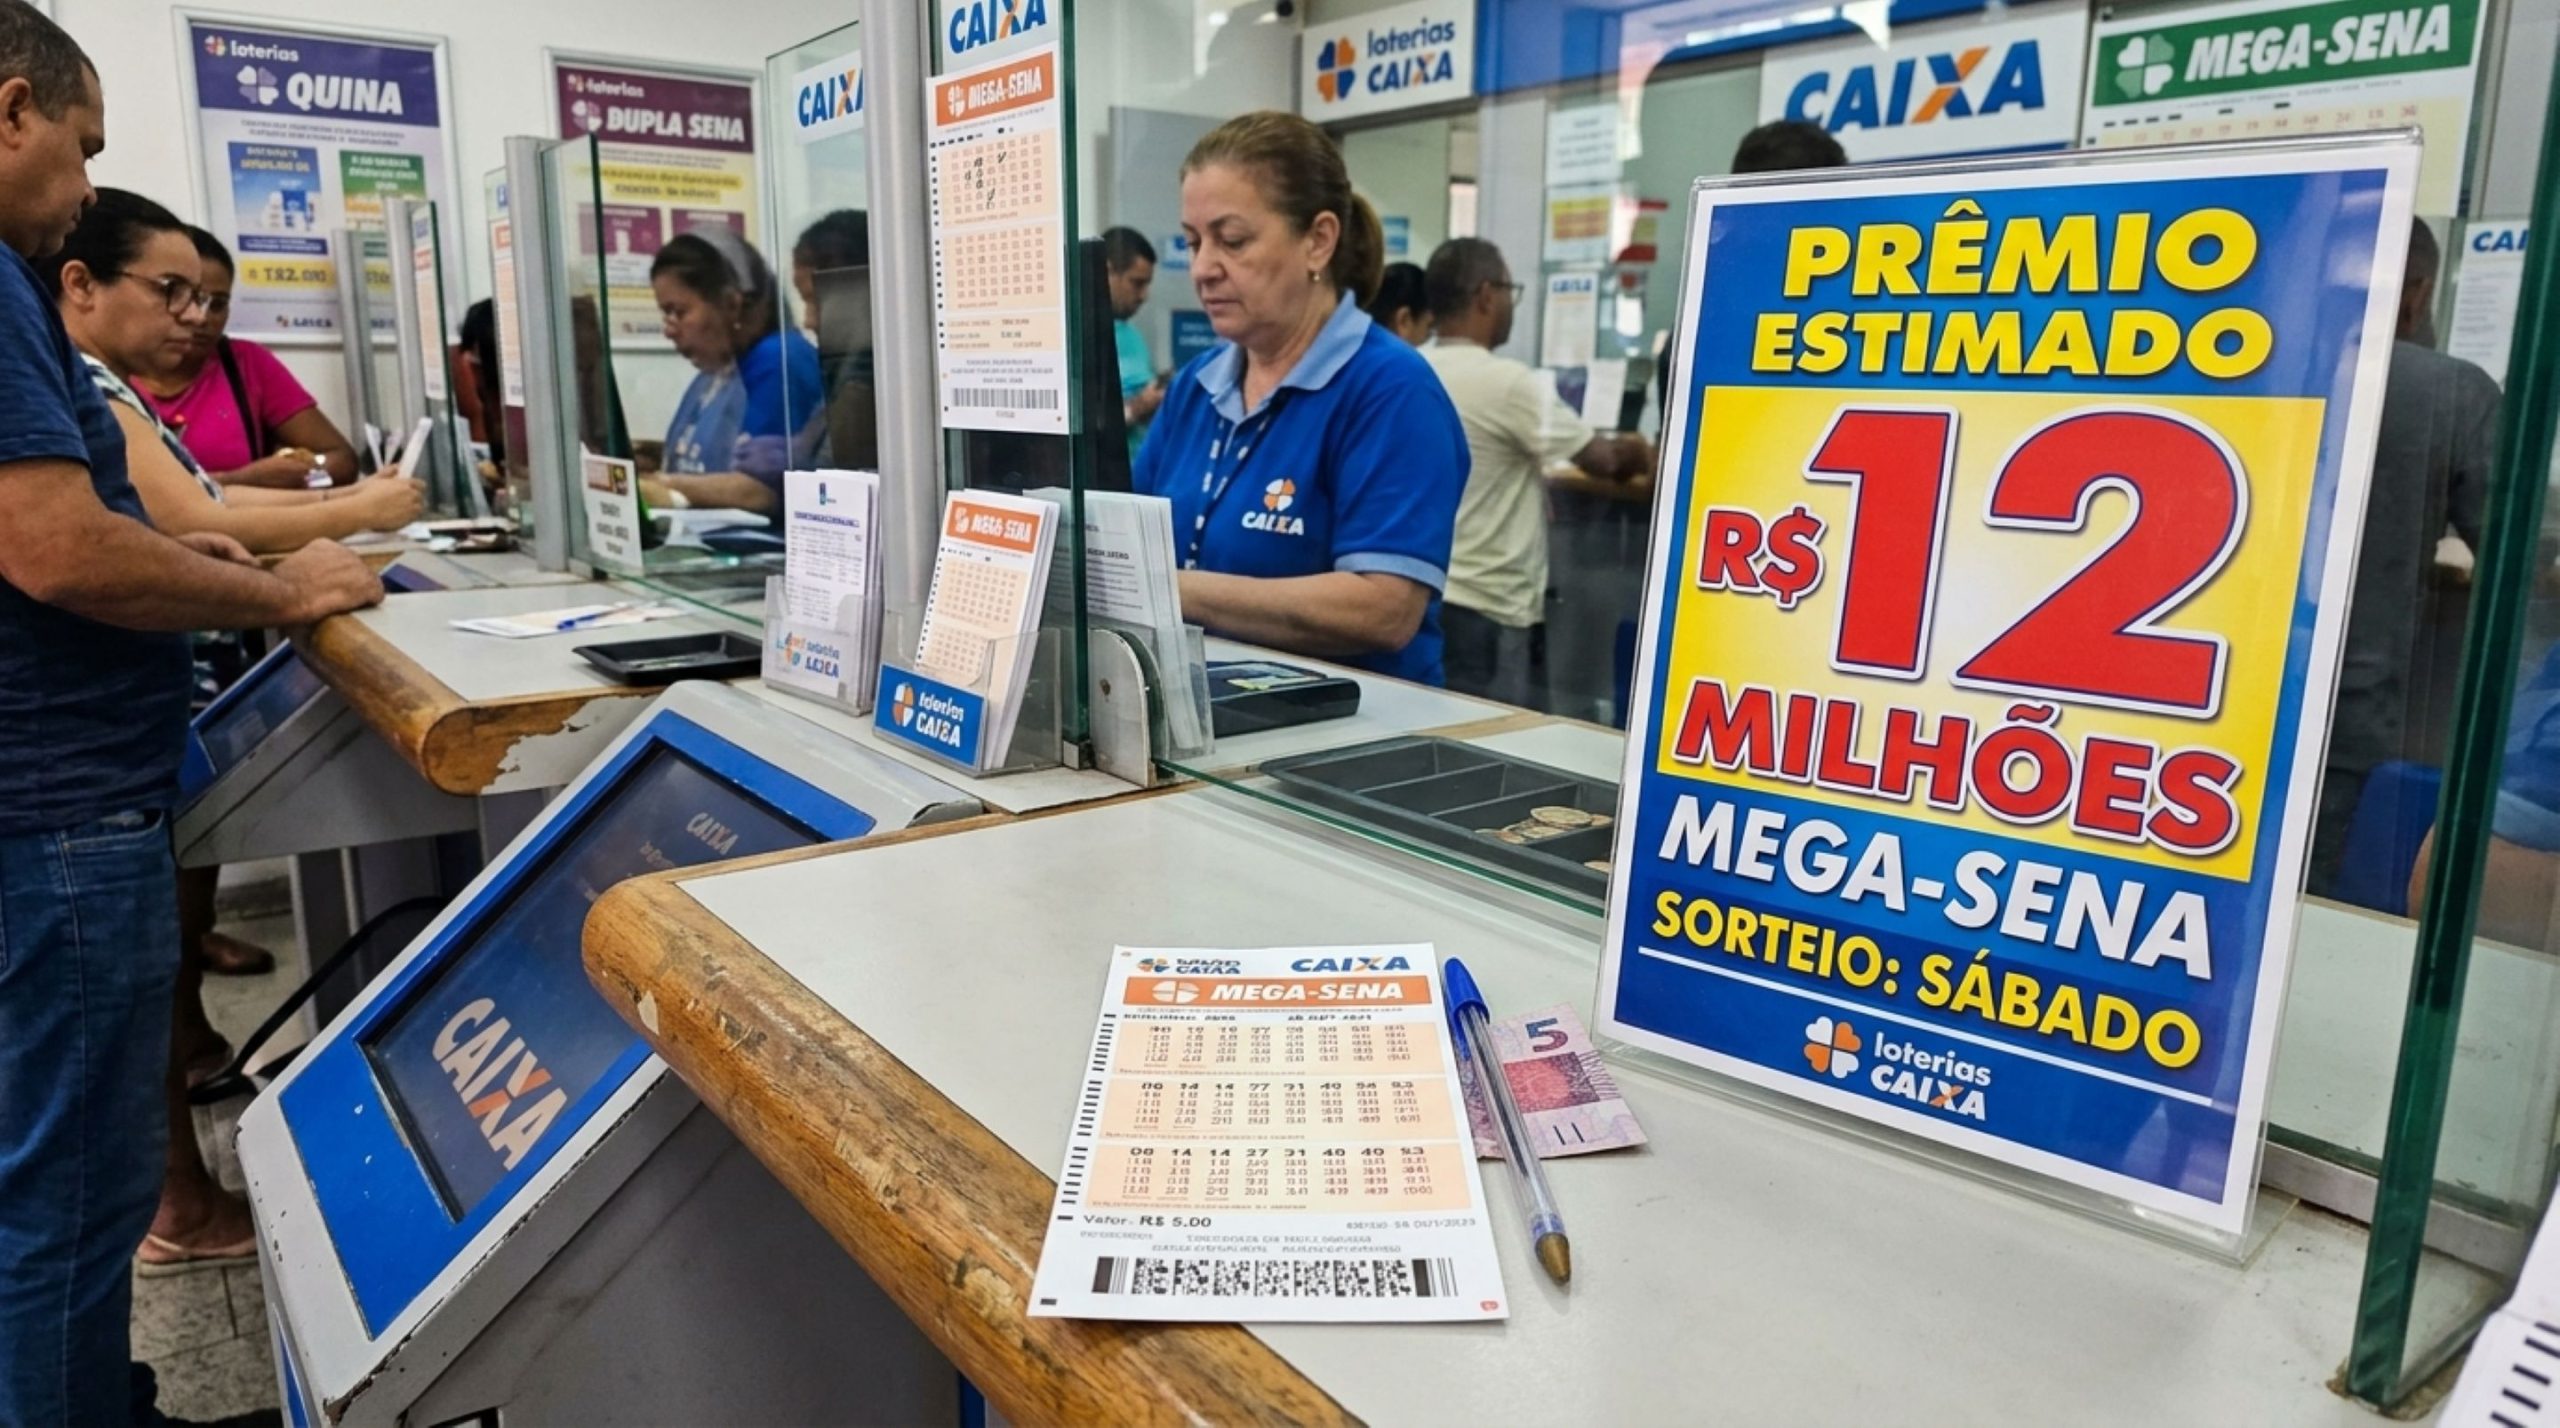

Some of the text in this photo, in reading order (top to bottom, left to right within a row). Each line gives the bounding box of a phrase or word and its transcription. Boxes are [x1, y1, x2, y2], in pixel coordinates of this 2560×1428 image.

[231, 40, 299, 62] loterias
[950, 0, 1047, 54] CAIXA
[1368, 18, 1455, 57] loterias
[2184, 4, 2450, 82] MEGA-SENA
[286, 72, 403, 115] QUINA
[1367, 50, 1453, 93] CAIXA
[1785, 39, 2044, 133] CAIXA
[607, 107, 744, 142] DUPLA SENA
[1783, 199, 2257, 297] PRÊMIO
[1751, 307, 2274, 378] ESTIMADO
[1697, 404, 2248, 718] R$ 12
[1671, 678, 2245, 855] MILHÕES
[1658, 794, 2212, 980] MEGA-SENA
[1209, 983, 1403, 1001] MEGA-SENA
[1291, 956, 1411, 974] CAIXA
[1651, 890, 2201, 1069] SORTEIO: SÁBADO
[1526, 1018, 1568, 1052] 5
[1874, 1031, 1991, 1087] loterias
[432, 997, 568, 1172] CAIXA
[1870, 1065, 1987, 1122] CAIXA
[1172, 1216, 1212, 1228] 5.00
